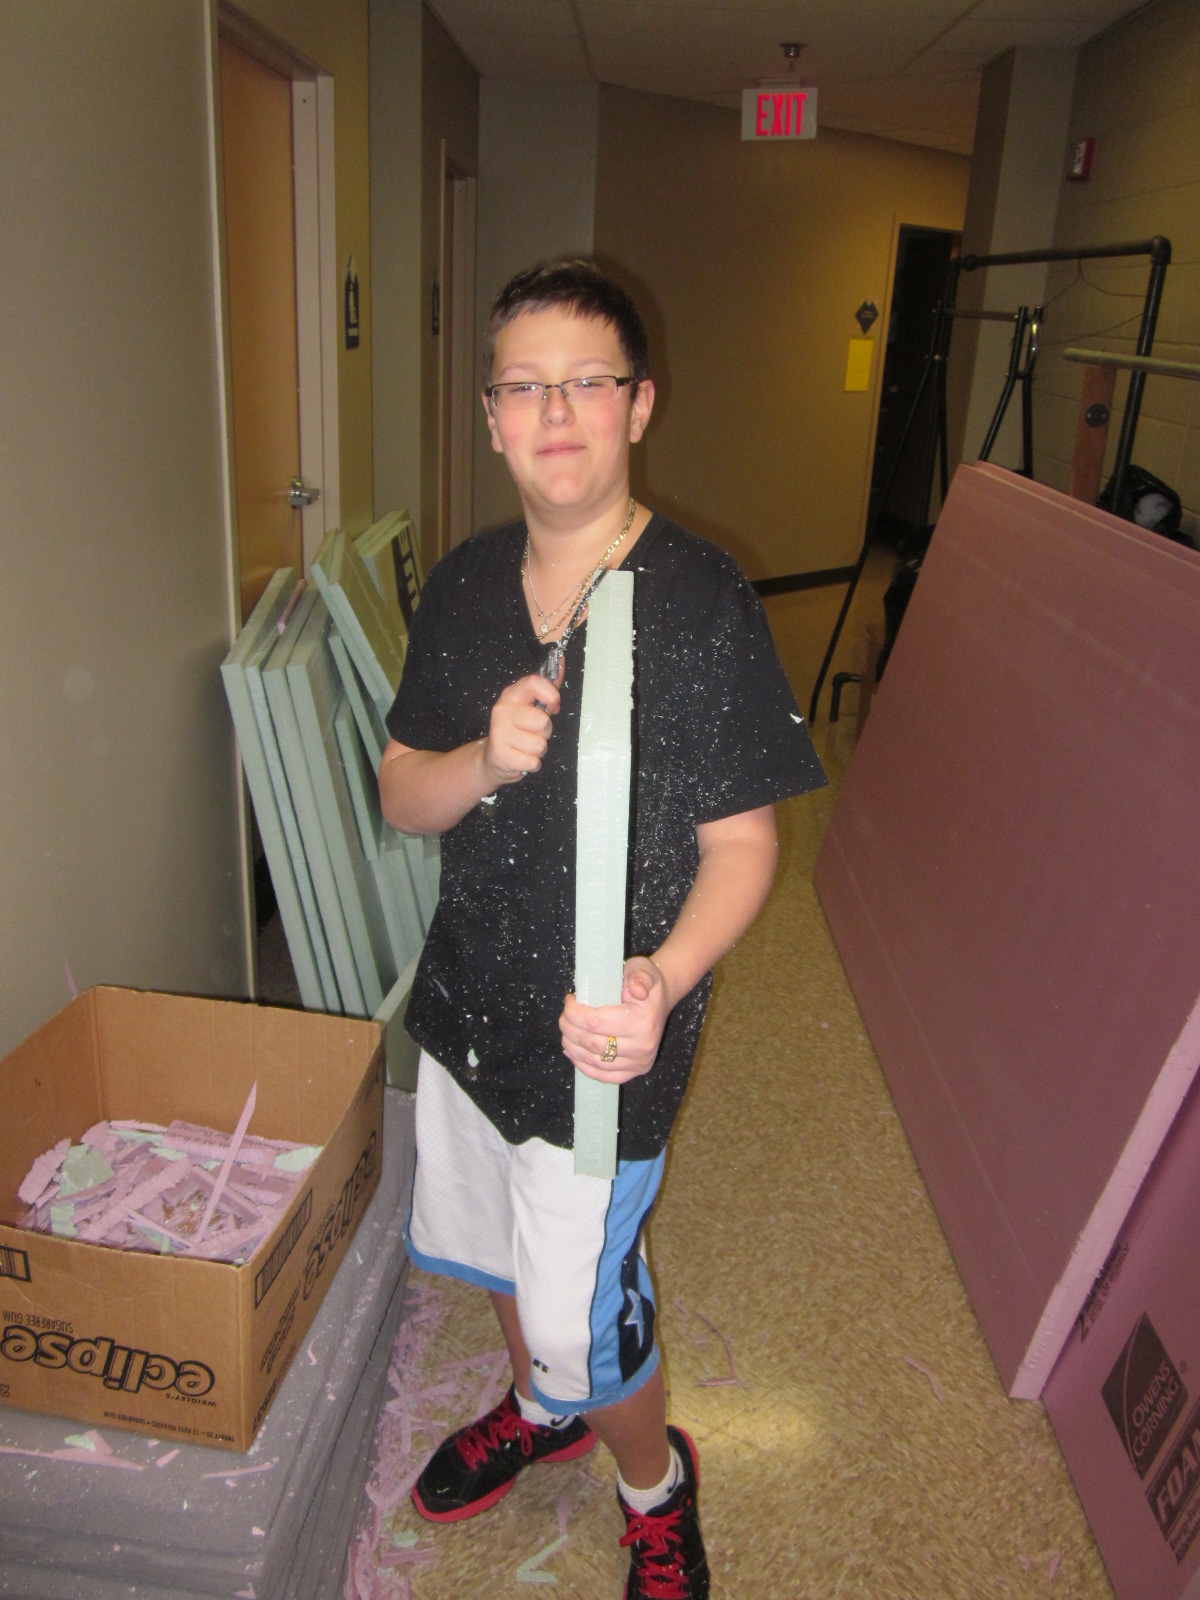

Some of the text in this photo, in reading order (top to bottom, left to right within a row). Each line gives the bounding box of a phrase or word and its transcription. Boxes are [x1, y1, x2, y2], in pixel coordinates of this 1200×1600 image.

[756, 92, 807, 137] EXIT
[2, 1310, 74, 1333] SUGARFREE GUM
[0, 1325, 215, 1397] eclipse
[165, 1393, 217, 1407] WRIGLEY'S
[1133, 1360, 1170, 1428] OWENS
[104, 1410, 117, 1418] GUM
[117, 1413, 146, 1425] SUGARFREE
[1133, 1376, 1179, 1457] CORNING
[151, 1420, 177, 1431] PACKAGES
[178, 1426, 192, 1434] PIECE
[214, 1433, 235, 1443] TWENTY
